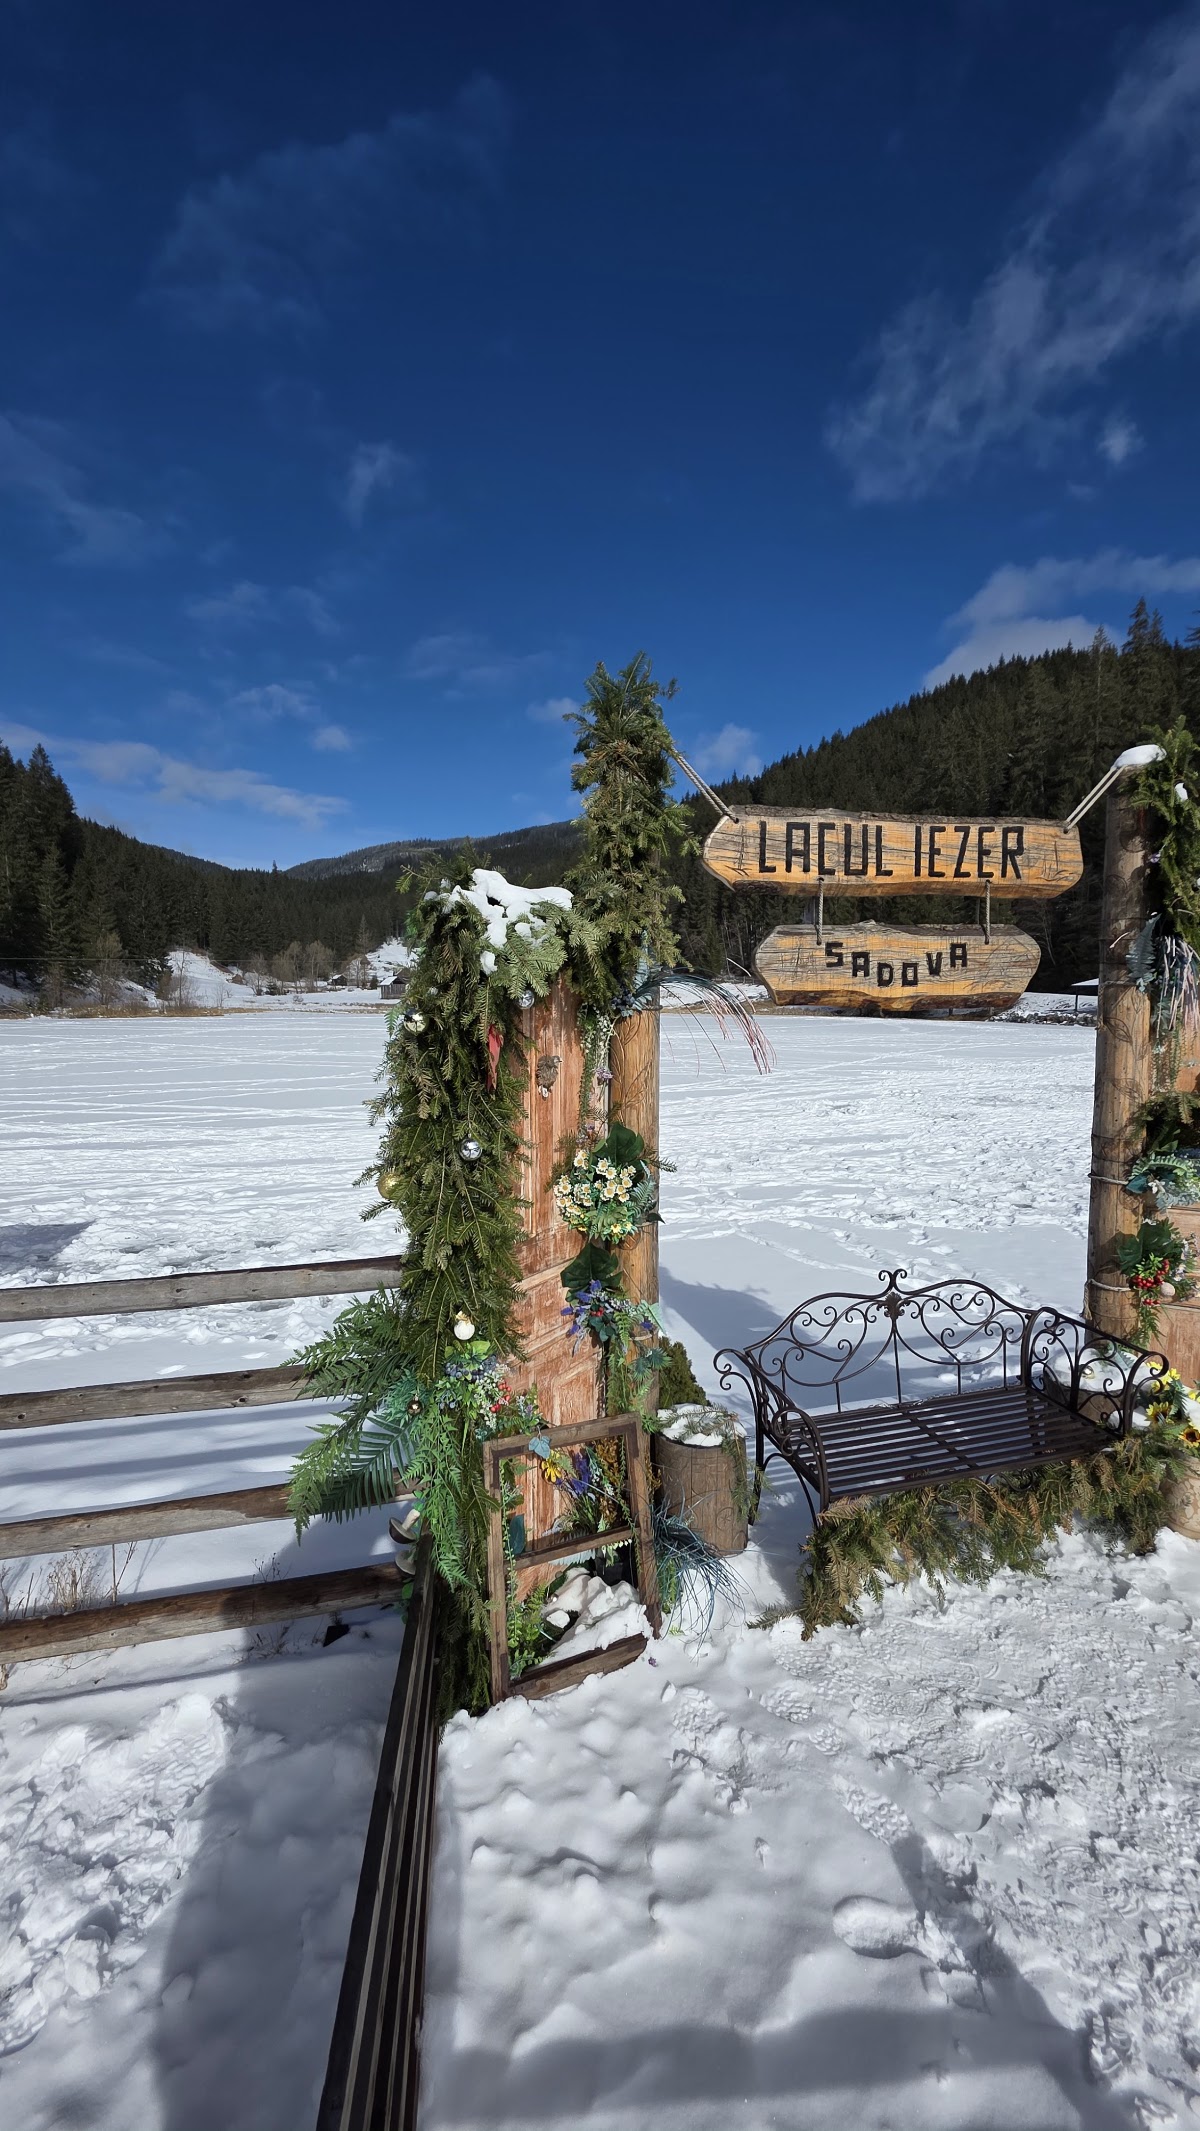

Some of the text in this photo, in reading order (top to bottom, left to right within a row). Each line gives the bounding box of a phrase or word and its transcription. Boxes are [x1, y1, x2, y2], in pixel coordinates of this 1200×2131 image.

[758, 821, 1025, 879] LACUL IEZER
[825, 941, 968, 987] SADOVA
